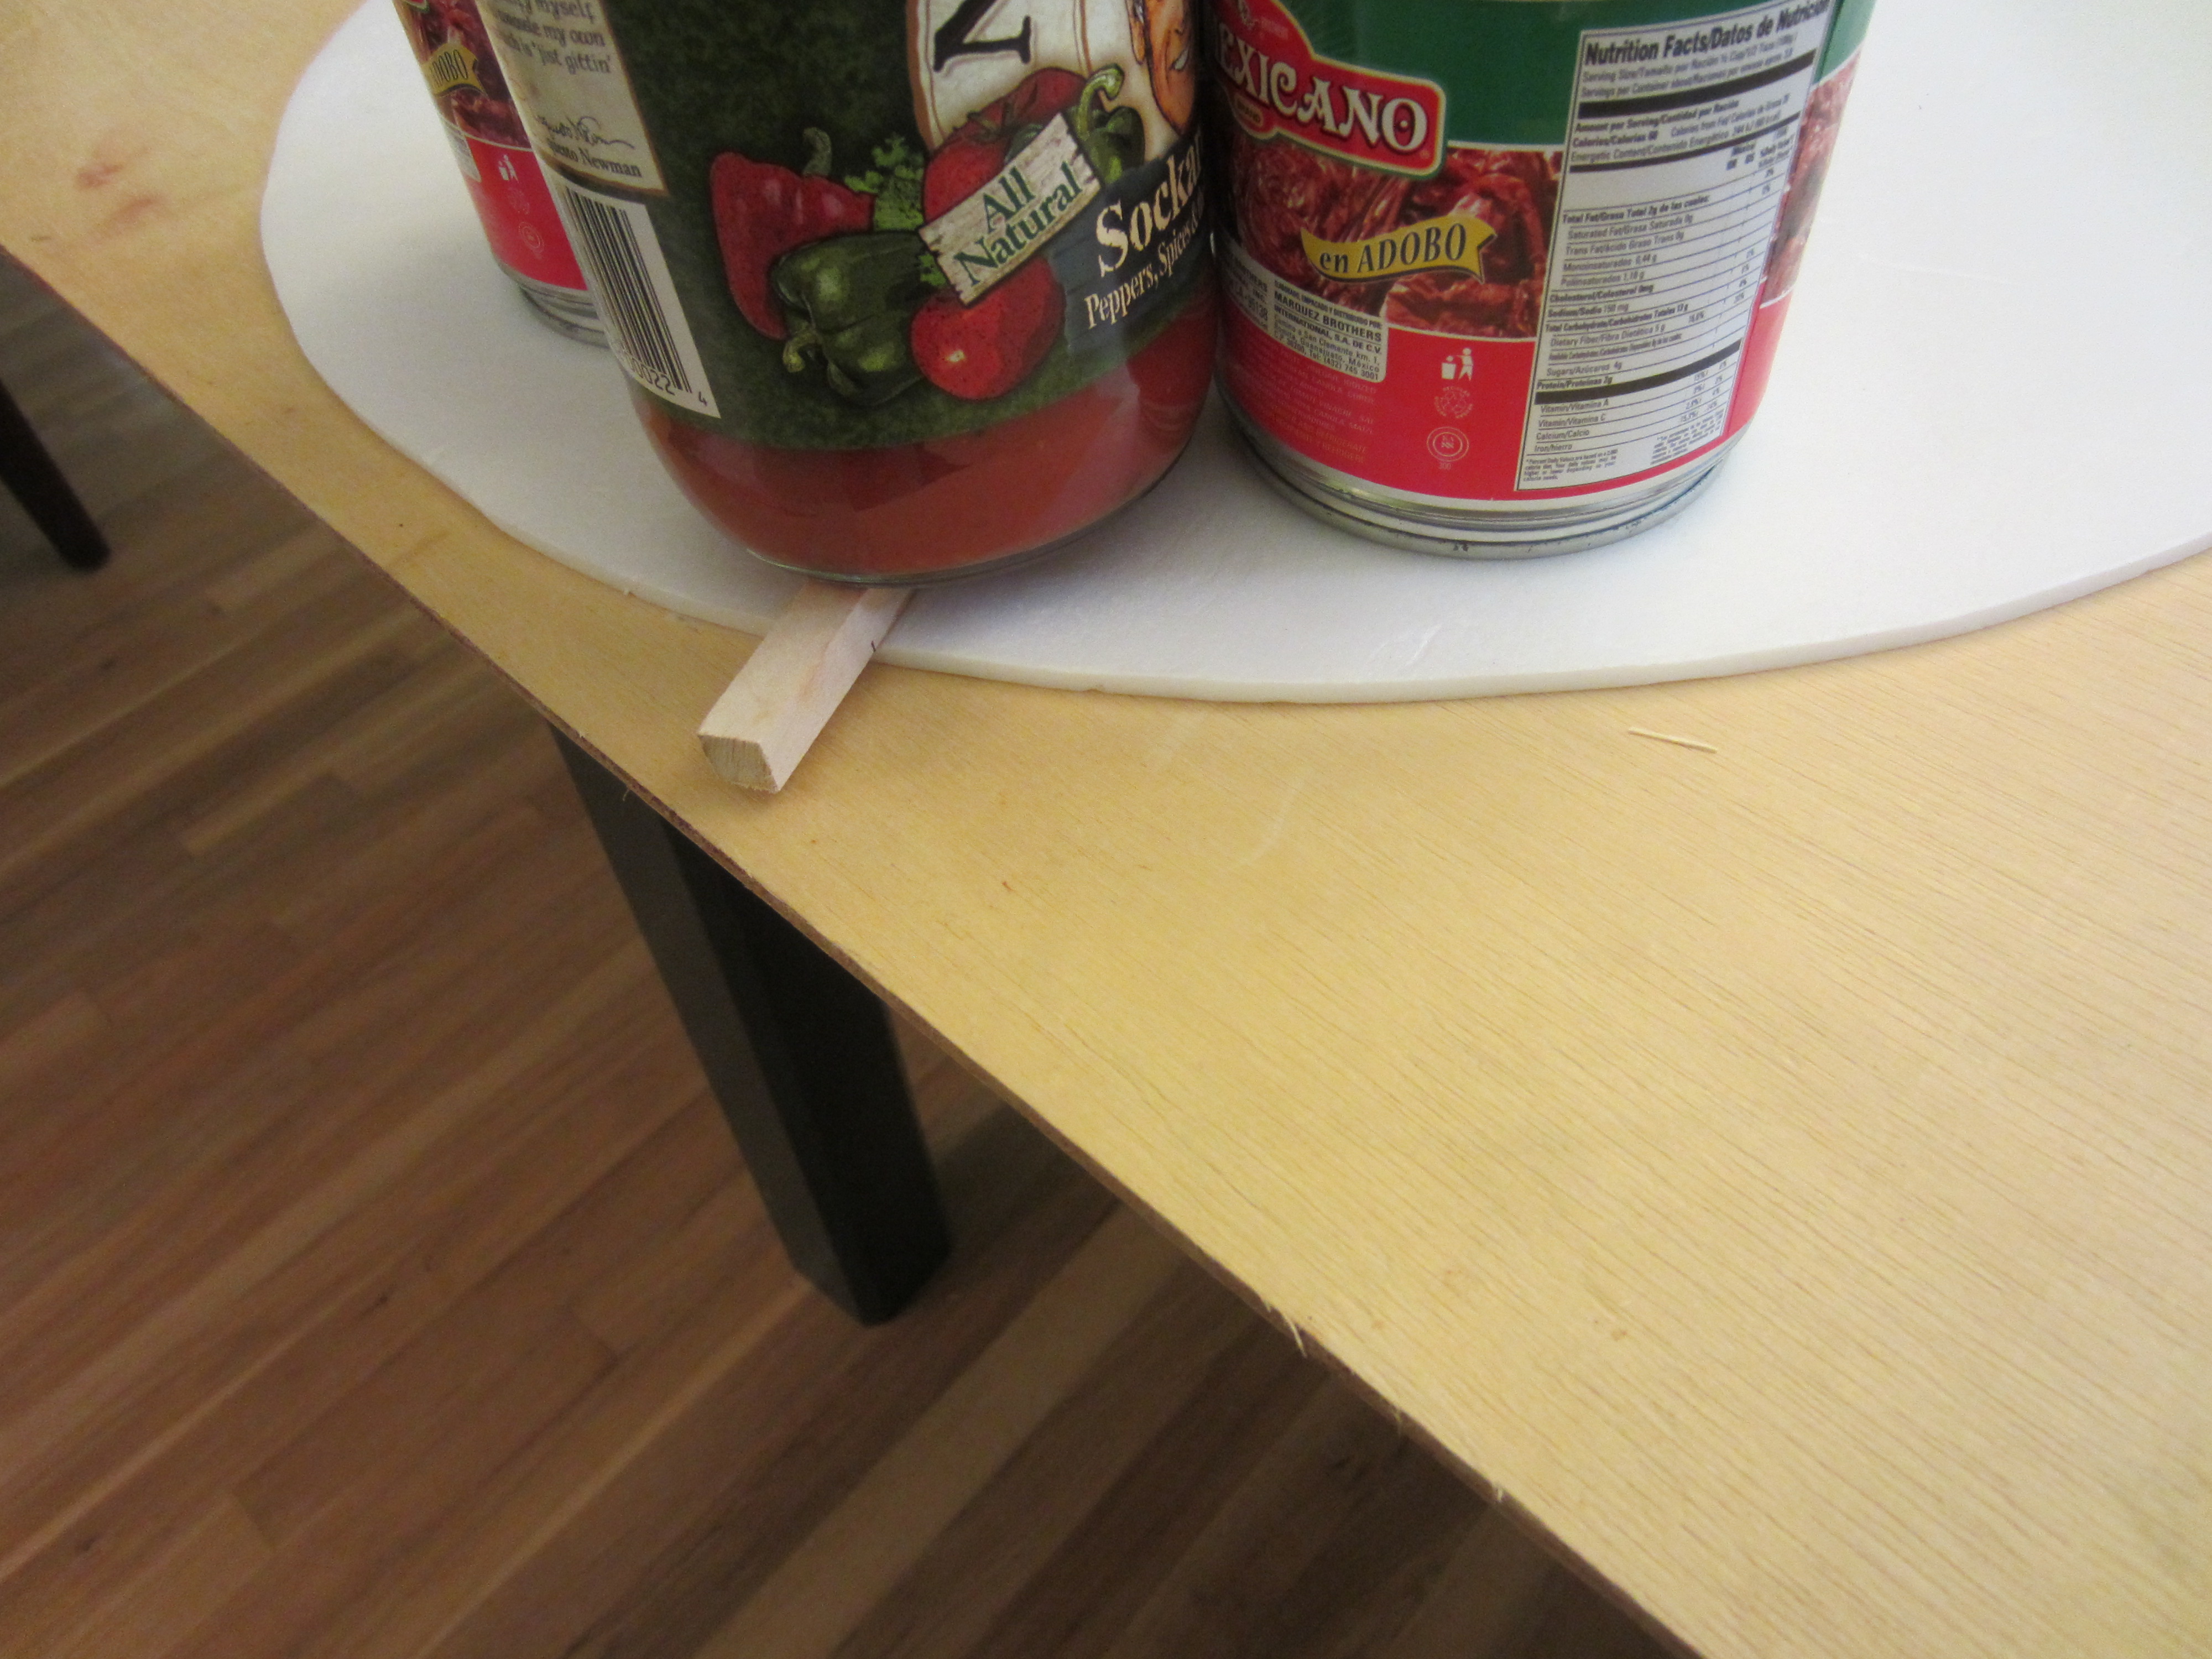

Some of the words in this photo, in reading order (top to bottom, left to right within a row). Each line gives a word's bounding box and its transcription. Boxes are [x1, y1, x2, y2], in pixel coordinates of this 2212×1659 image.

[1584, 38, 1660, 65] Nutrition
[1218, 22, 1427, 152] EXICANO
[578, 147, 643, 178] Newman
[952, 160, 1083, 286] Natural
[983, 166, 1035, 235] All
[1319, 251, 1349, 274] en
[1357, 223, 1467, 273] ADOBO
[1084, 262, 1159, 330] Peppers,
[1274, 291, 1320, 321] MARQUEZ
[1322, 315, 1382, 342] BROTHERS
[1353, 340, 1364, 349] DE
[698, 391, 707, 406] 4
